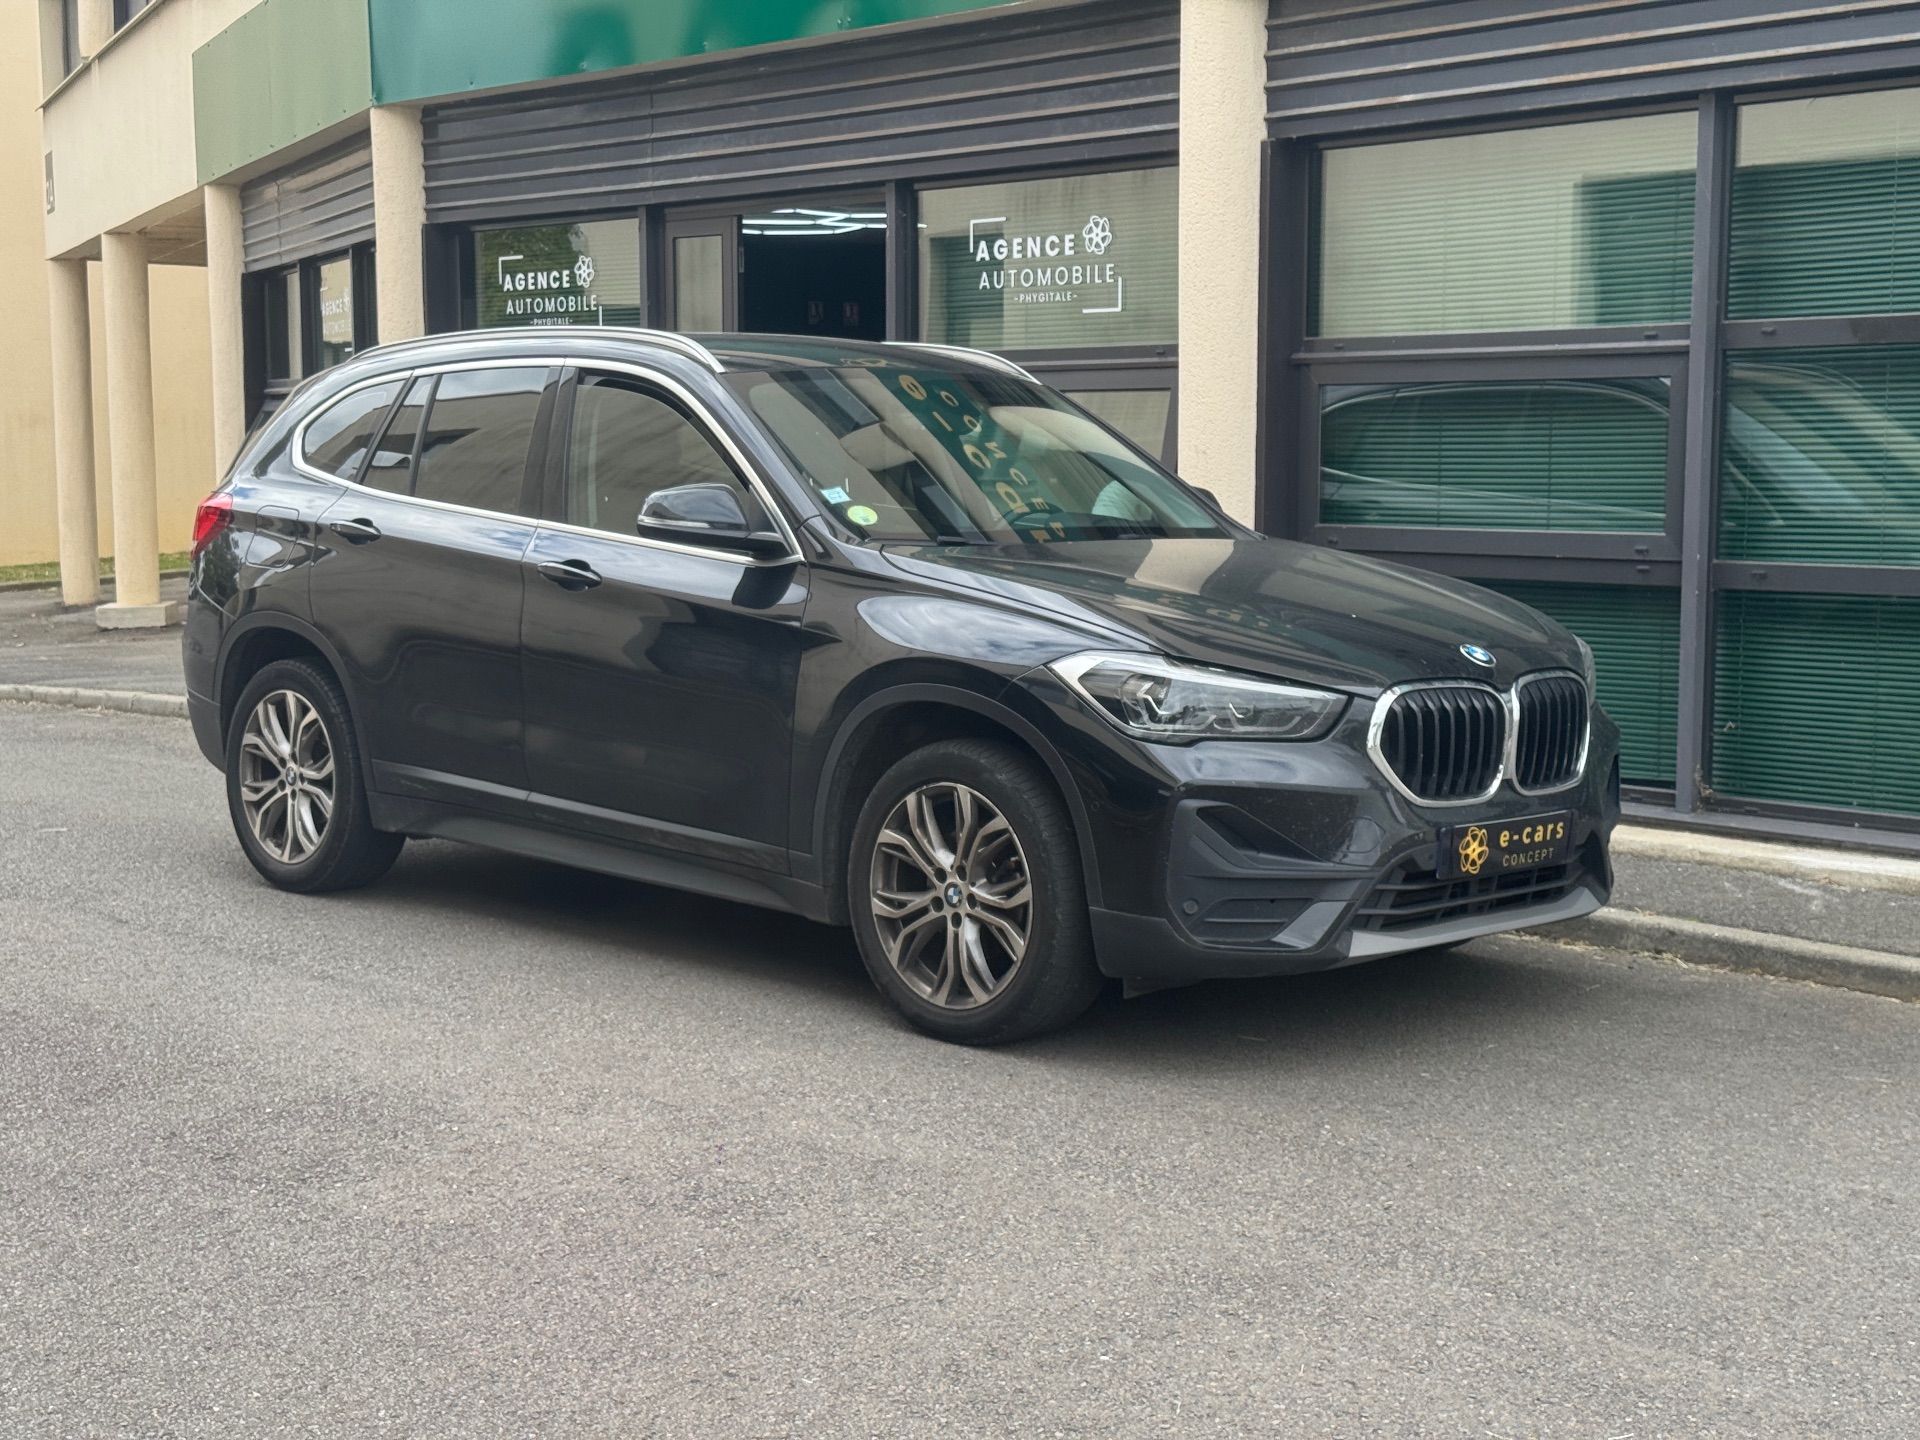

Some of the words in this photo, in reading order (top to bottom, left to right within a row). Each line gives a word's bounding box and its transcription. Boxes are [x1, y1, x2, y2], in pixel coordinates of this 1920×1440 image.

[975, 233, 1075, 262] AGENCE
[503, 269, 571, 292] AGENCE
[979, 263, 1115, 290] AUTOMOBILE
[506, 294, 598, 315] AUTOMOBILE
[1499, 821, 1564, 848] e-cars
[1502, 847, 1554, 867] CONCEPT
